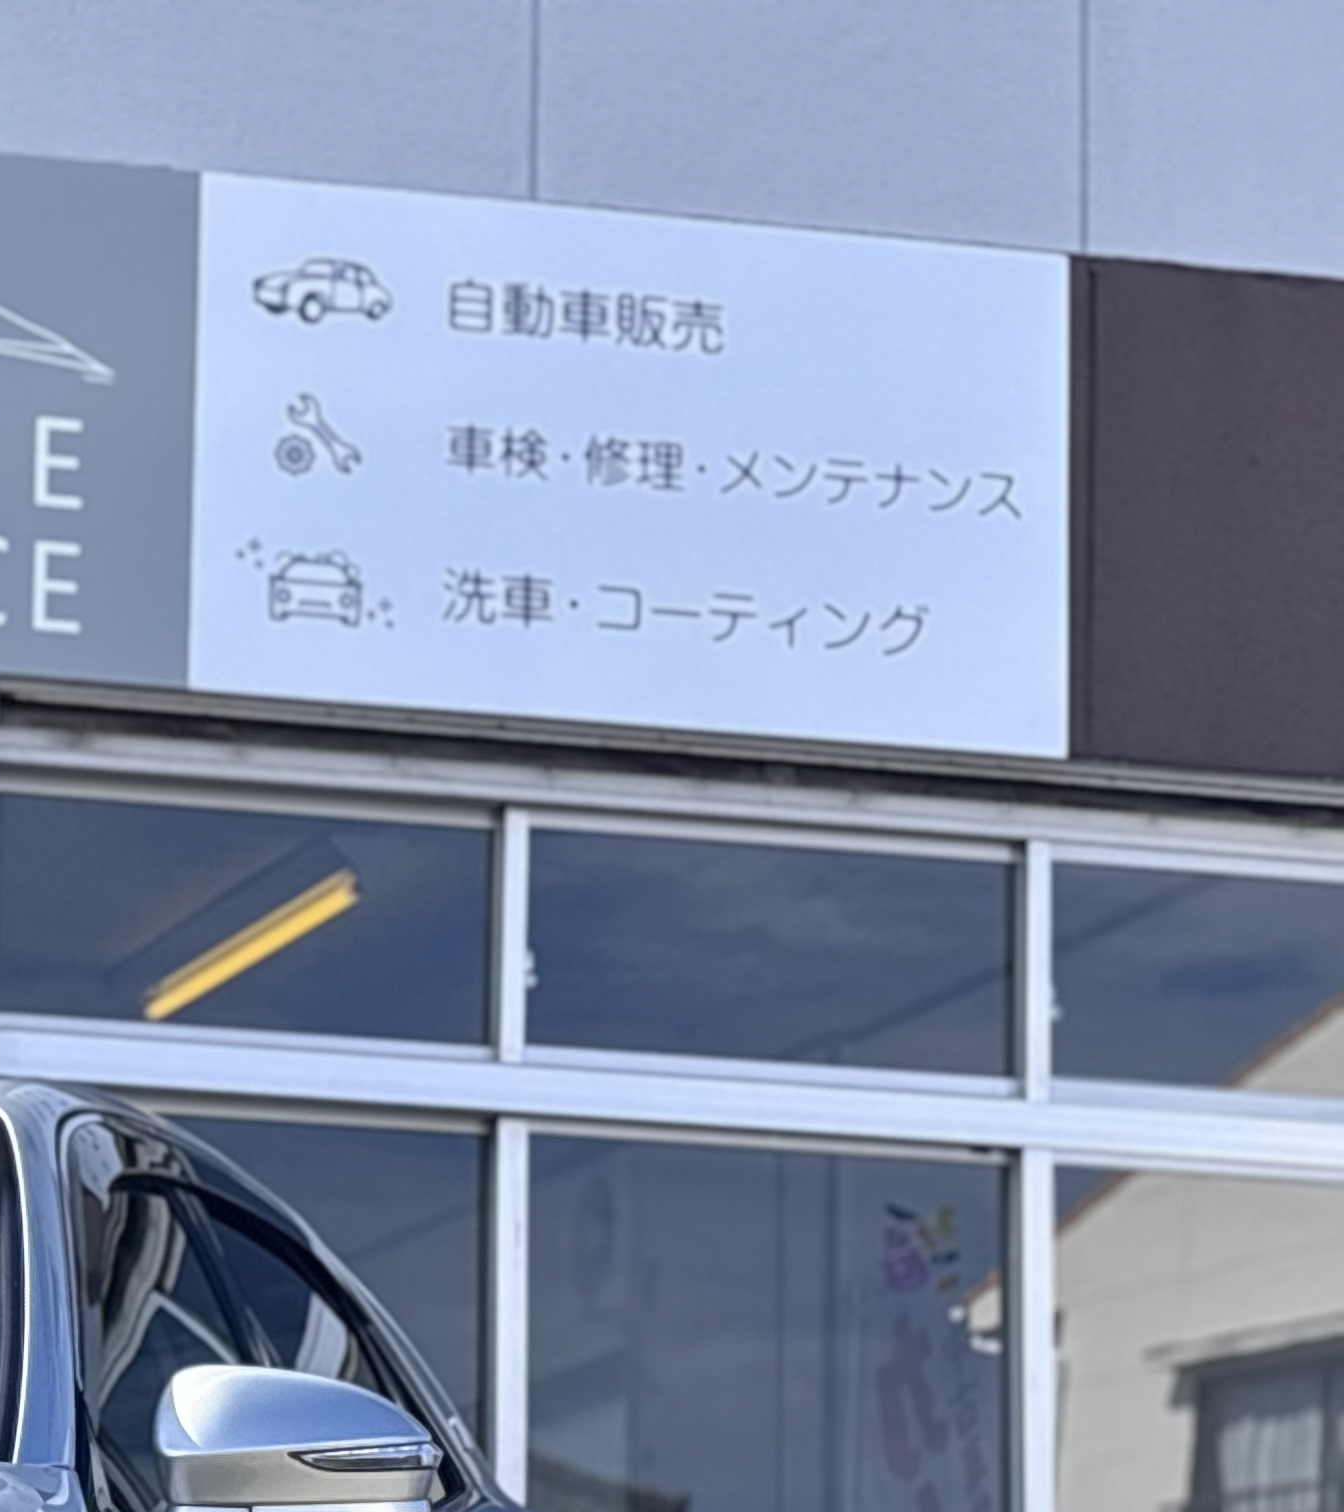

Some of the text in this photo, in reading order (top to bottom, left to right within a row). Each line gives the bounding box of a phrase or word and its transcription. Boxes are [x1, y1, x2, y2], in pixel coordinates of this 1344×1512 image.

[448, 278, 725, 355] 自動車販売
[447, 424, 1023, 520] 車検・修理・メンテナンス
[442, 567, 930, 657] 洗車・コーティング
